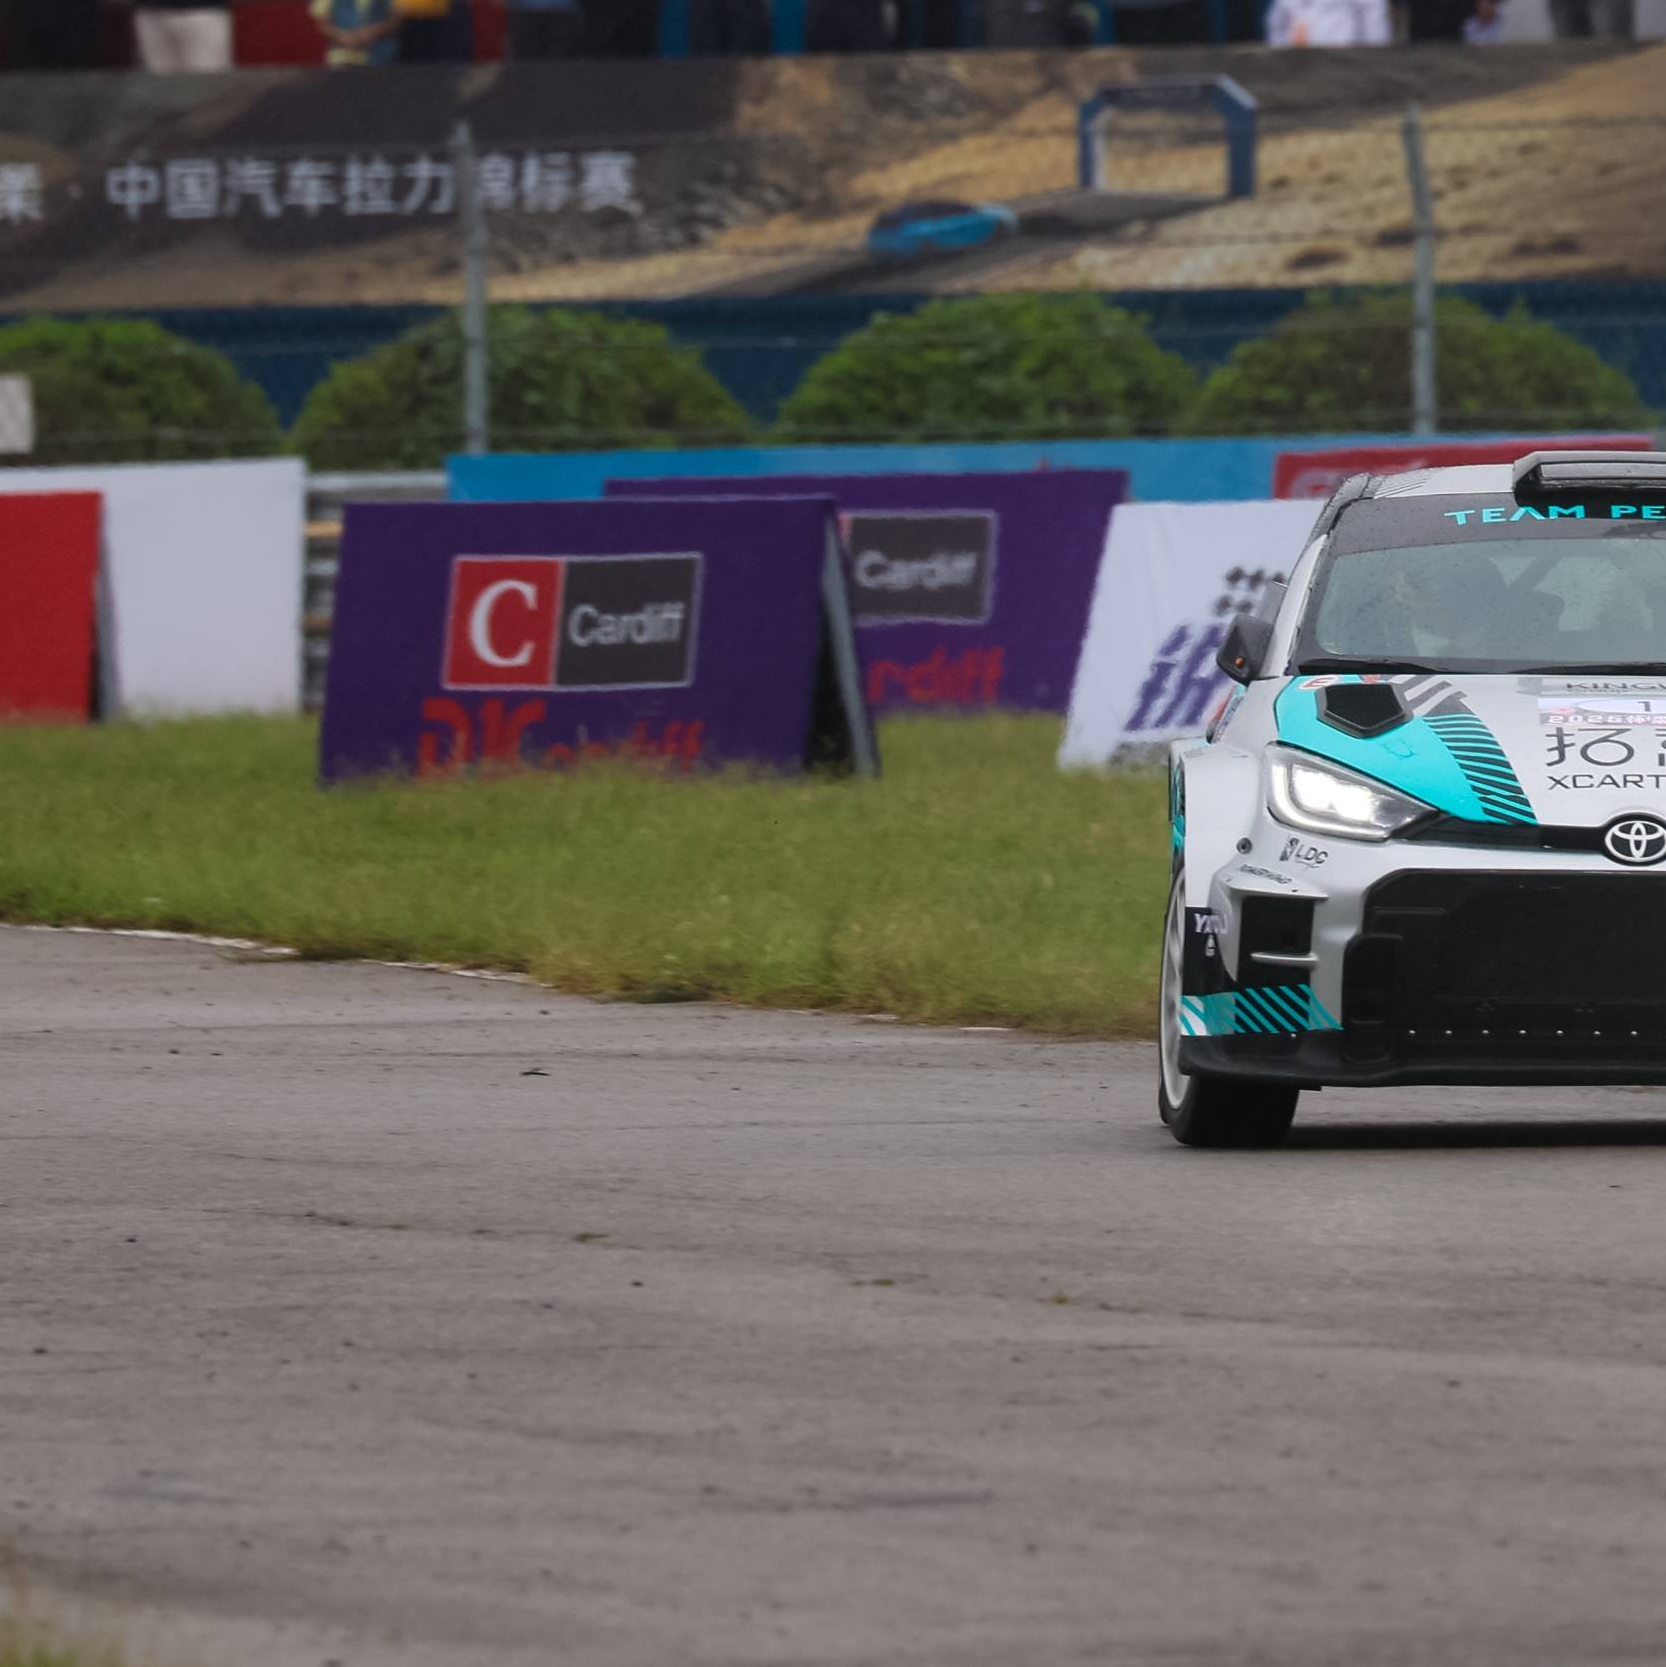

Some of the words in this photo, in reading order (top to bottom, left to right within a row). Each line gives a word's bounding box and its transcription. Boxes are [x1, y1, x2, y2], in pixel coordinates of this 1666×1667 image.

[1444, 505, 1586, 527] TEAM
[853, 551, 979, 591] Cardiff
[469, 580, 540, 669] C
[568, 601, 687, 648] Cardiff
[1636, 701, 1652, 713] 1
